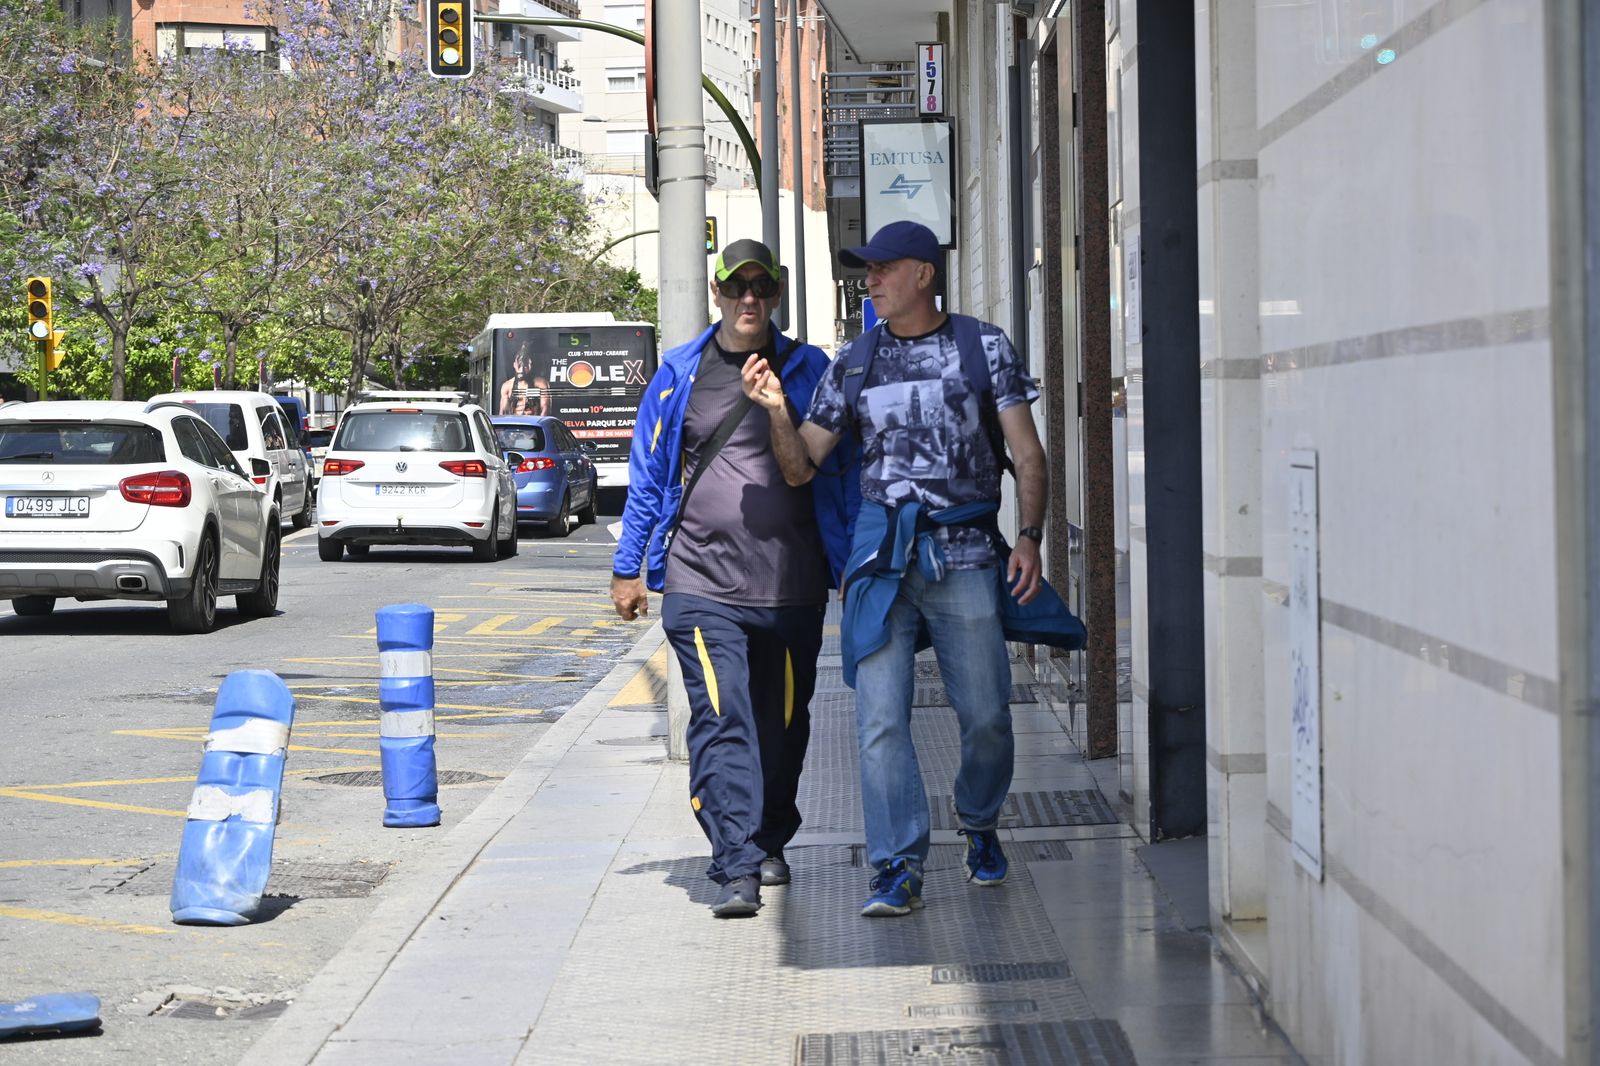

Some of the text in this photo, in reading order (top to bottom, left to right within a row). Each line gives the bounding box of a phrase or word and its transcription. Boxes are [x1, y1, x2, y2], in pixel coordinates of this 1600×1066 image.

[870, 151, 945, 166] EMTUSA
[570, 336, 580, 346] 5
[381, 485, 426, 495] 9242 KCR
[16, 498, 86, 512] 0499 JLC
